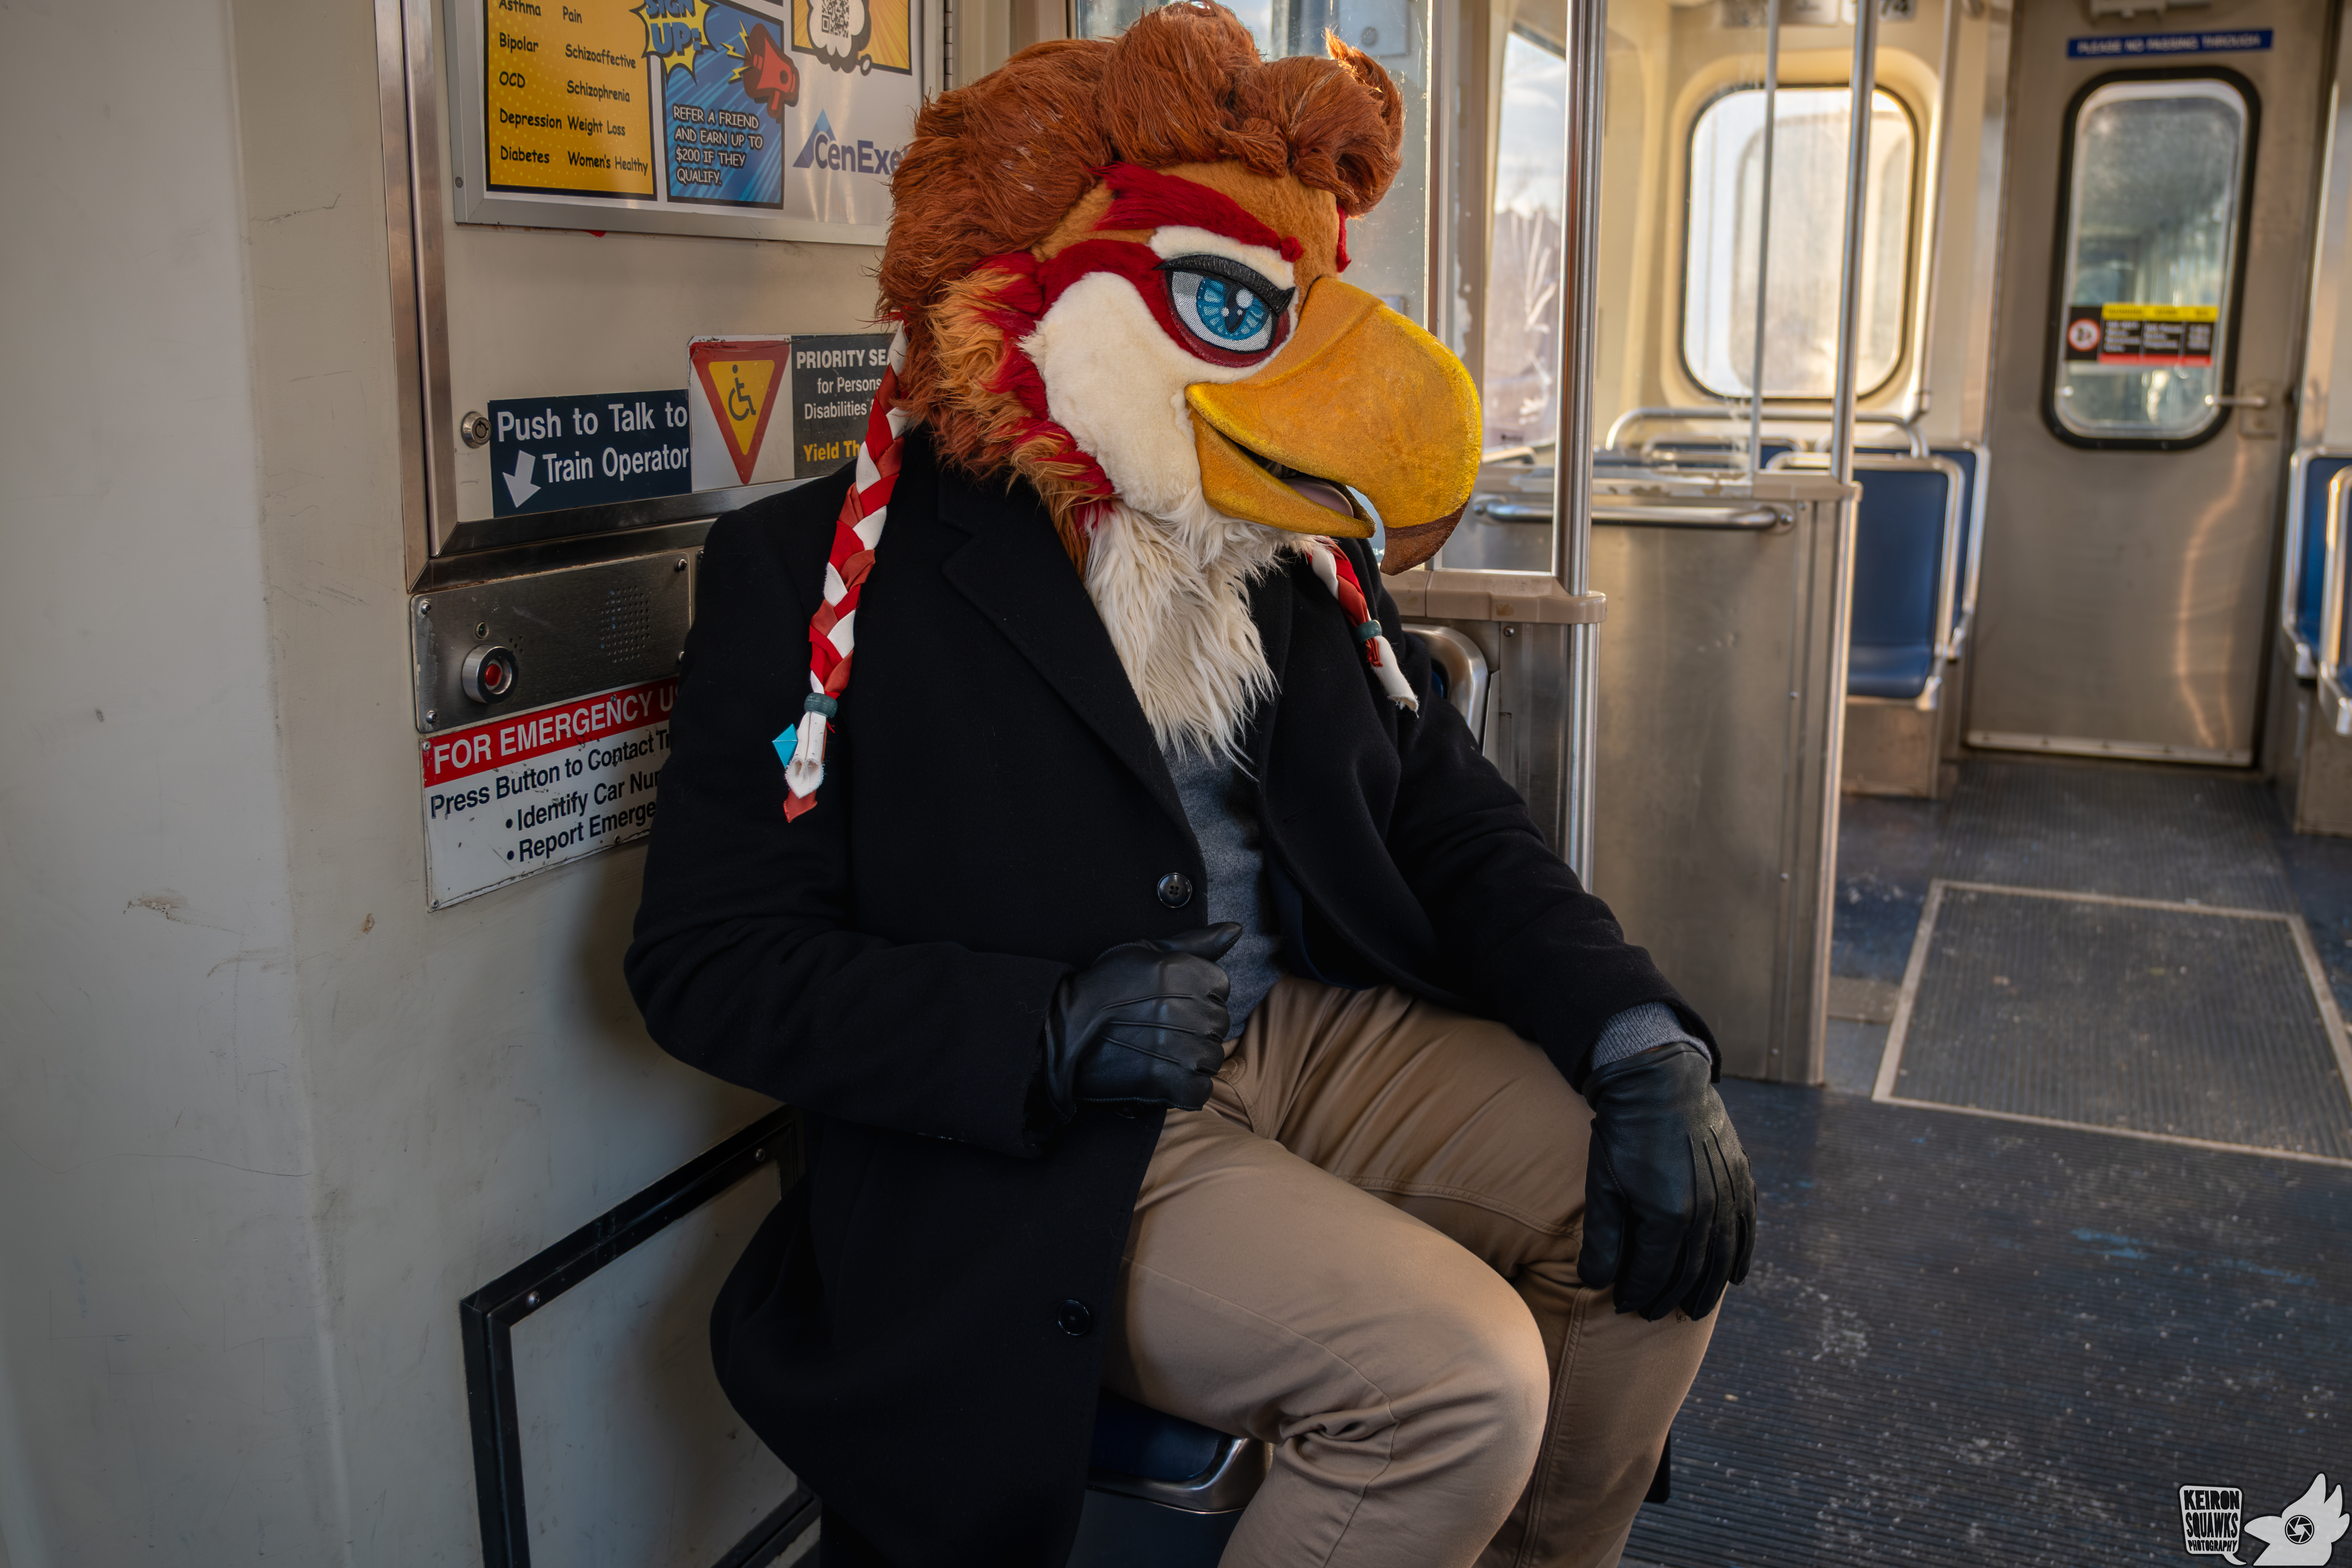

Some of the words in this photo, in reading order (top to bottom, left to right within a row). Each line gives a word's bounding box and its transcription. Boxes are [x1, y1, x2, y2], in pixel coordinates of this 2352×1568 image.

[499, 0, 541, 16] Asthma
[563, 6, 582, 24] Pain
[645, 0, 695, 18] SIGN
[500, 32, 539, 53] Bipolar
[2076, 40, 2122, 55] PLEASE
[2125, 38, 2146, 53] NO
[2201, 32, 2262, 48] THROUGH
[565, 43, 636, 69] Schizoaffective
[499, 71, 525, 88] OCD
[567, 80, 630, 103] Schizophrenia
[500, 108, 562, 129] Depression
[567, 115, 603, 136] Weight
[607, 120, 625, 136] Loss
[674, 105, 704, 122] REFER
[708, 112, 715, 123] A
[719, 112, 759, 128] FRIEND
[675, 128, 697, 142] AND
[700, 130, 728, 145] EARN
[731, 134, 745, 146] UP
[748, 135, 763, 148] TO
[500, 145, 550, 163] Diabetes
[567, 151, 611, 169] Women's
[615, 156, 648, 176] Healthy
[676, 146, 700, 163] $200
[703, 151, 714, 163] IF
[718, 153, 746, 166] THEY
[815, 134, 909, 176] CenExe
[677, 168, 722, 184] QUALIFY.
[796, 349, 866, 369] PRIORITY
[869, 349, 891, 366] SE
[817, 378, 834, 394] for
[837, 376, 882, 393] Persons
[804, 400, 867, 420] Disabilities
[497, 408, 562, 442] Push
[573, 408, 598, 435] to
[608, 402, 655, 432] Talk
[665, 401, 688, 427] to
[803, 441, 839, 462] Yield
[543, 451, 593, 483] Train
[602, 444, 689, 481] Operator
[434, 733, 492, 774] FOR
[500, 691, 653, 757] EMERGENCY
[660, 685, 678, 712] U
[431, 786, 490, 819] Press
[496, 765, 560, 800] Button
[565, 758, 583, 778] to
[588, 734, 654, 770] Contact
[517, 791, 588, 831] Identify
[594, 781, 625, 805] Car
[519, 822, 584, 862] Report
[589, 801, 656, 838] Emerge
